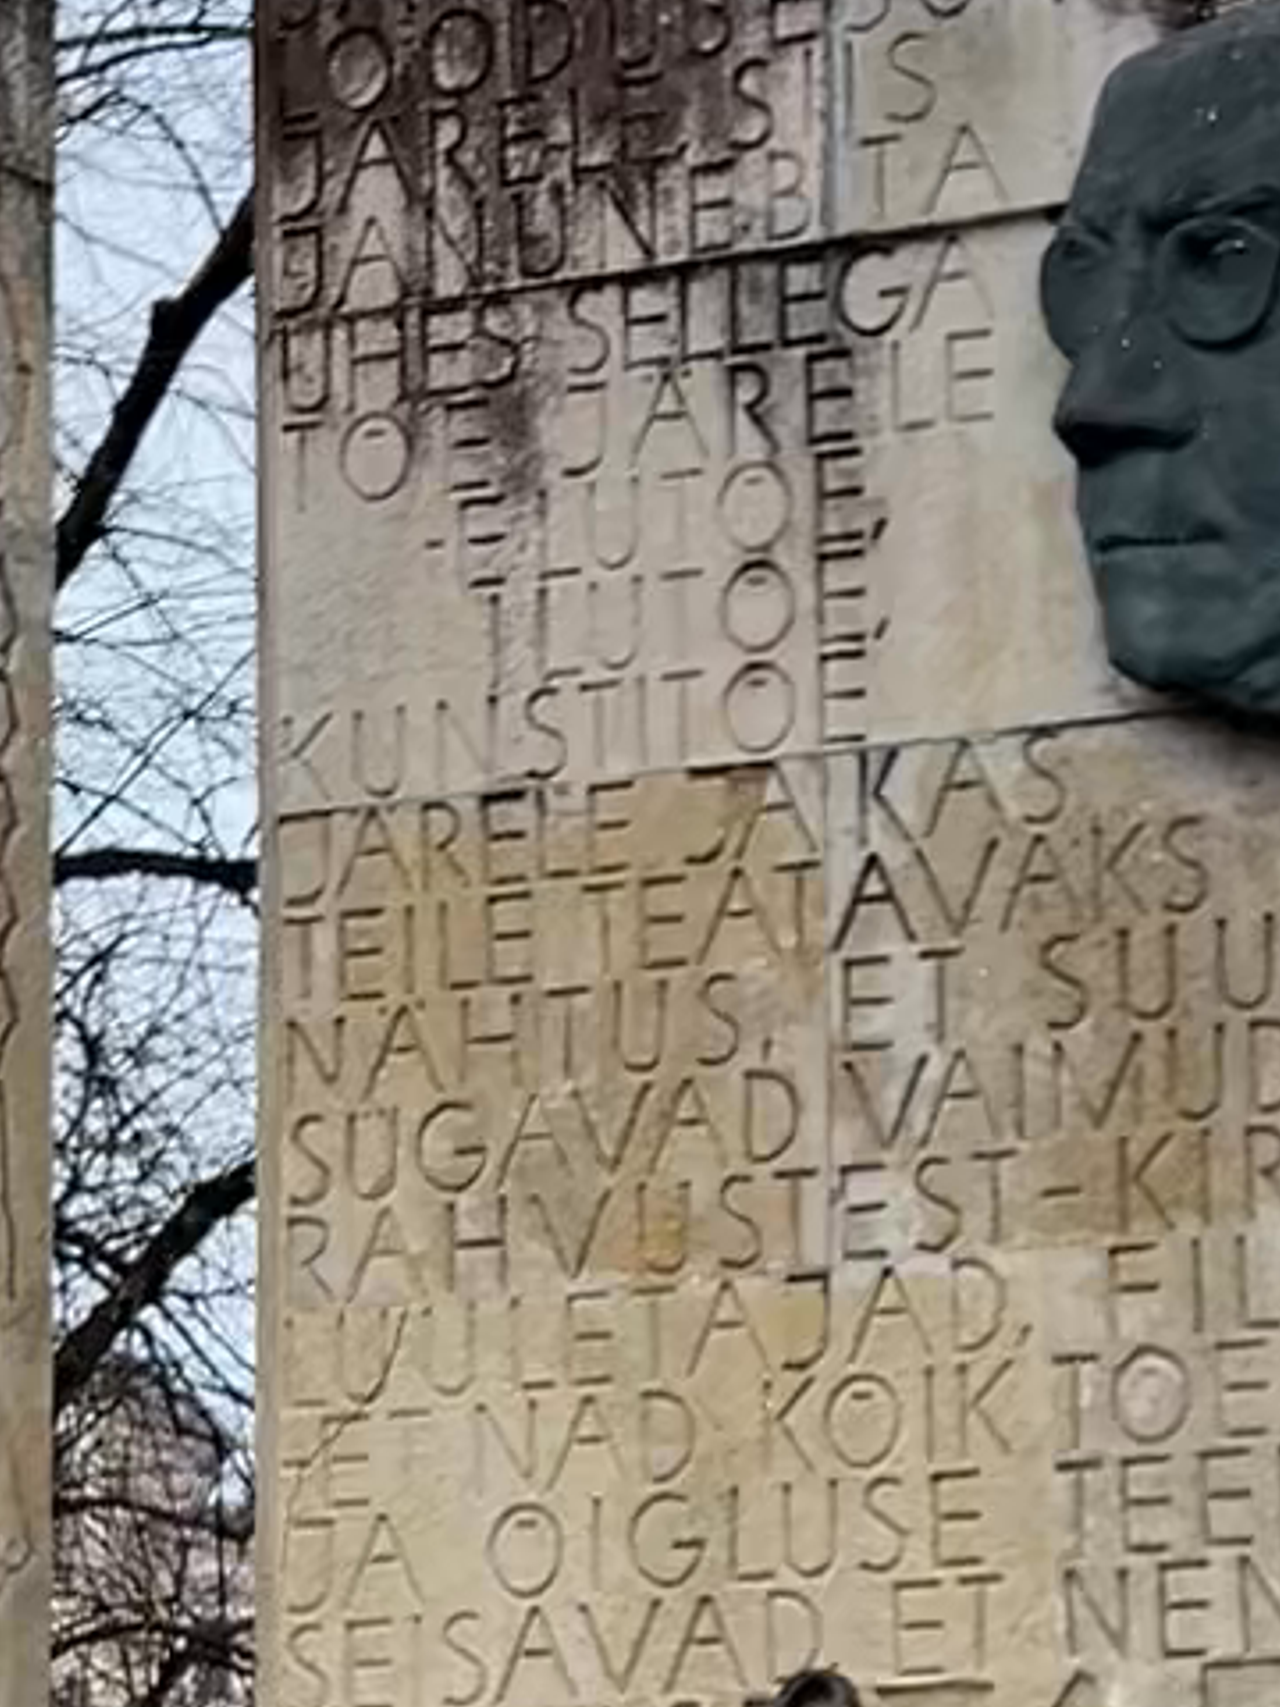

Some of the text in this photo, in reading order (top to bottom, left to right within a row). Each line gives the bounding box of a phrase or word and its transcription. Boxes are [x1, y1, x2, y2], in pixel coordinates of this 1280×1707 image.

[730, 30, 936, 155] SIIS
[273, 124, 1009, 316] JANUNEB TA
[568, 235, 993, 375] SELLEGA
[282, 329, 993, 511] TÕE JÄRELE
[280, 651, 867, 805] KUNSTITÕE
[278, 781, 633, 907] JÄRELE
[688, 759, 817, 866] JA
[860, 728, 1065, 847] KAS
[282, 893, 535, 998] TEILE
[582, 815, 1208, 983] TEATAVAKS
[285, 974, 773, 1095] NÄHTUS,
[842, 948, 964, 1051] ET
[288, 1069, 800, 1207] SÜGAVAD
[284, 1150, 1017, 1303] RAHVUSTEST
[283, 1258, 1032, 1408] LUULETAJAD,
[322, 1407, 431, 1509] ET
[473, 1390, 694, 1495] NAD
[764, 1358, 1012, 1475] KÕIK
[283, 1511, 422, 1613] JA
[487, 1467, 983, 1600] ÕIGLUSE
[893, 1575, 1004, 1675] ET
